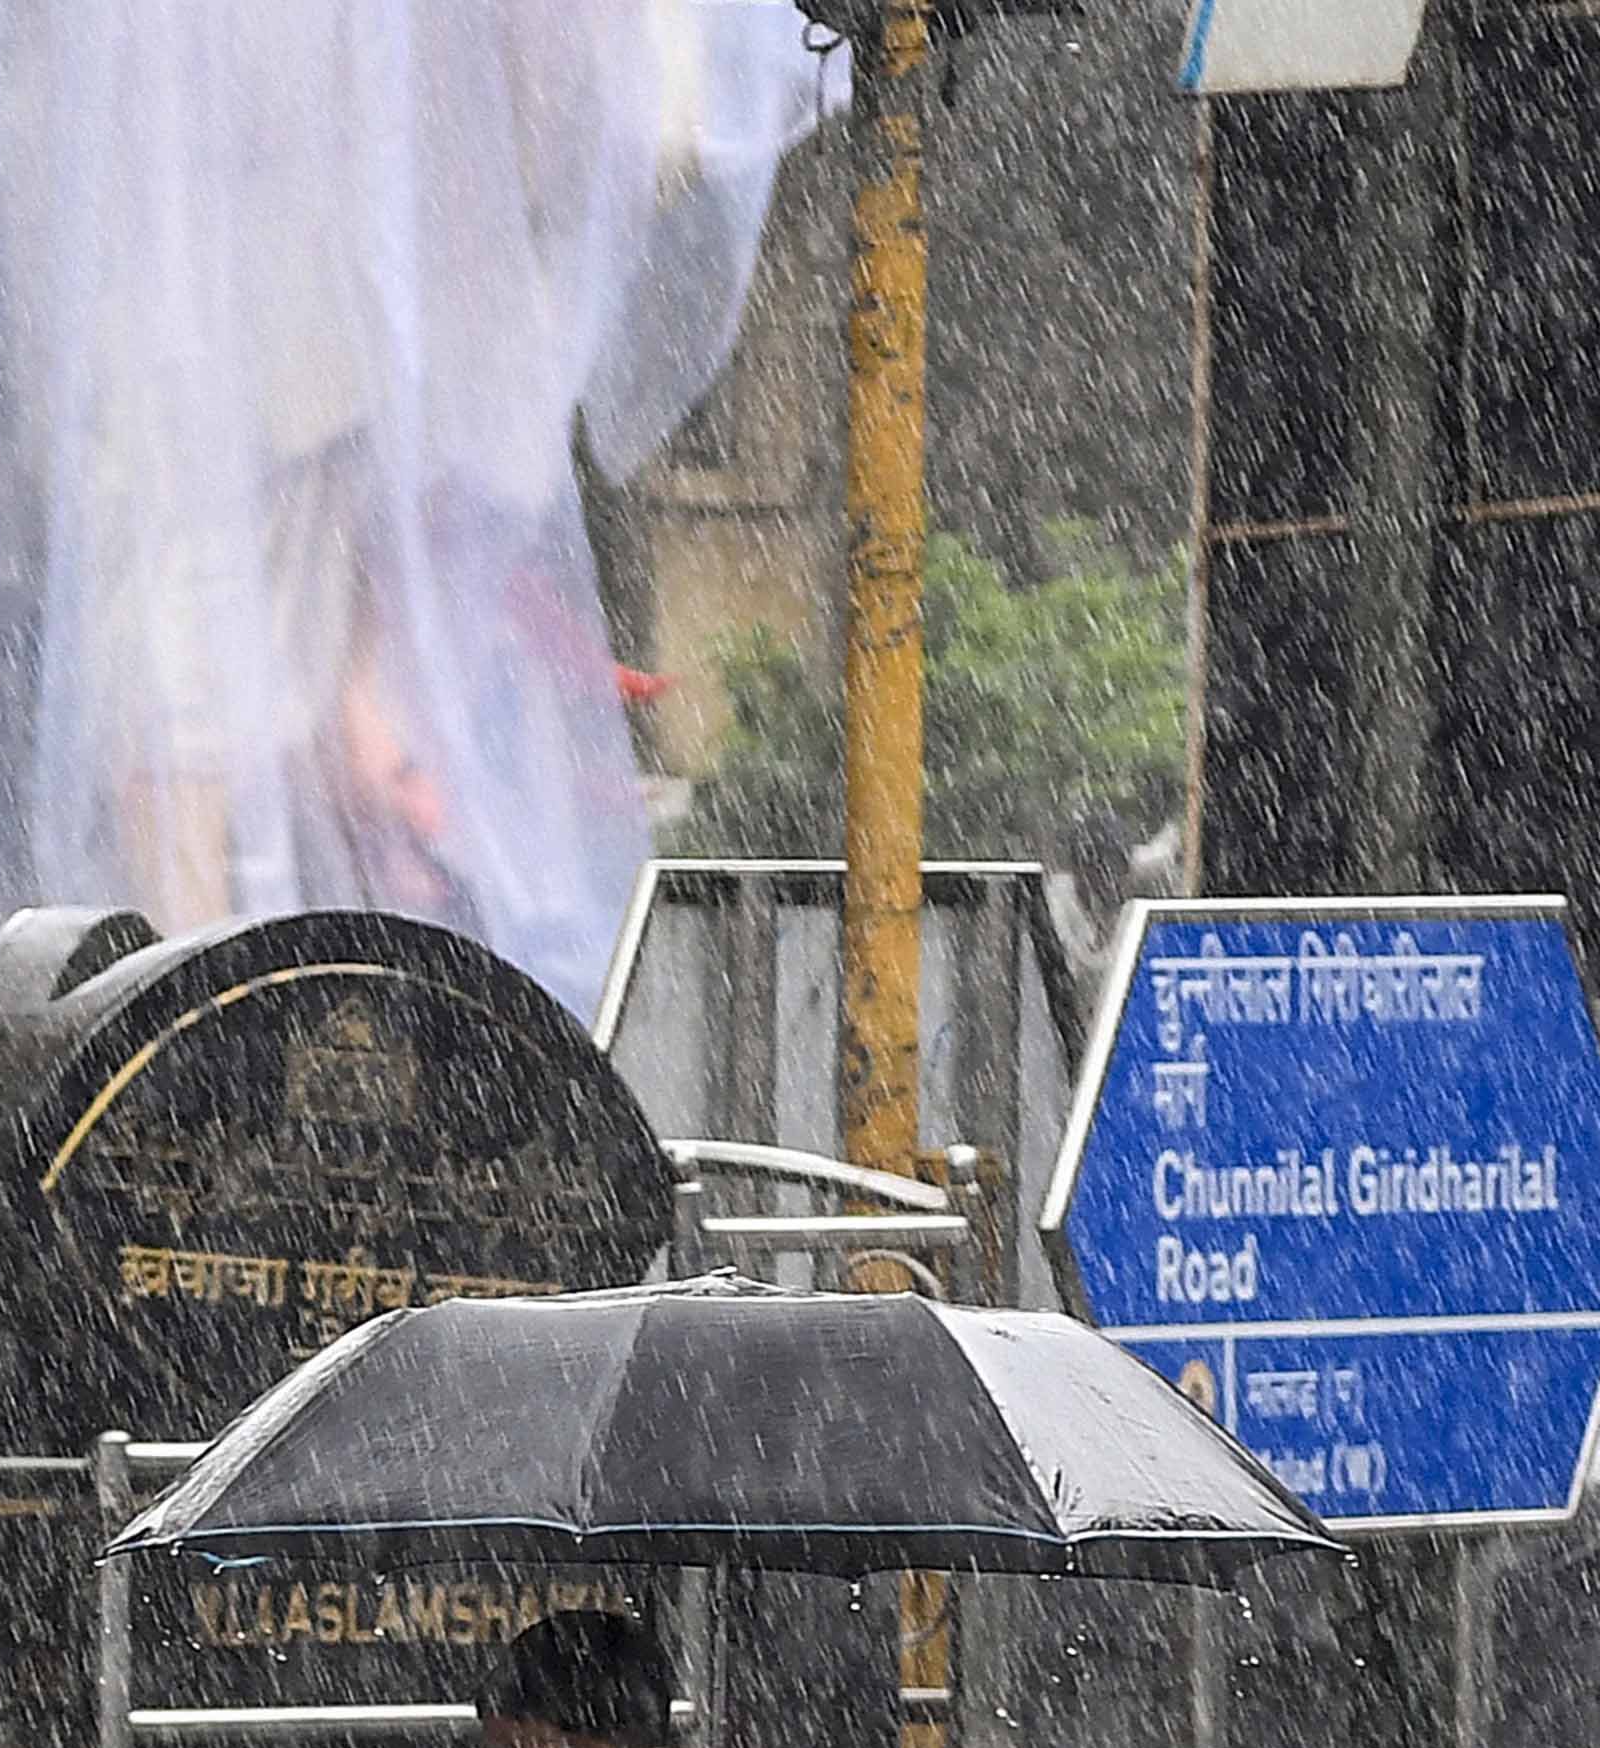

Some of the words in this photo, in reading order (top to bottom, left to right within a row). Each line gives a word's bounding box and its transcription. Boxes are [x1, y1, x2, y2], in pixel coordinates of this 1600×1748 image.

[1153, 1149, 1338, 1221] Chunnilal
[1348, 1144, 1560, 1216] Giridharilal
[1156, 1233, 1257, 1303] Road
